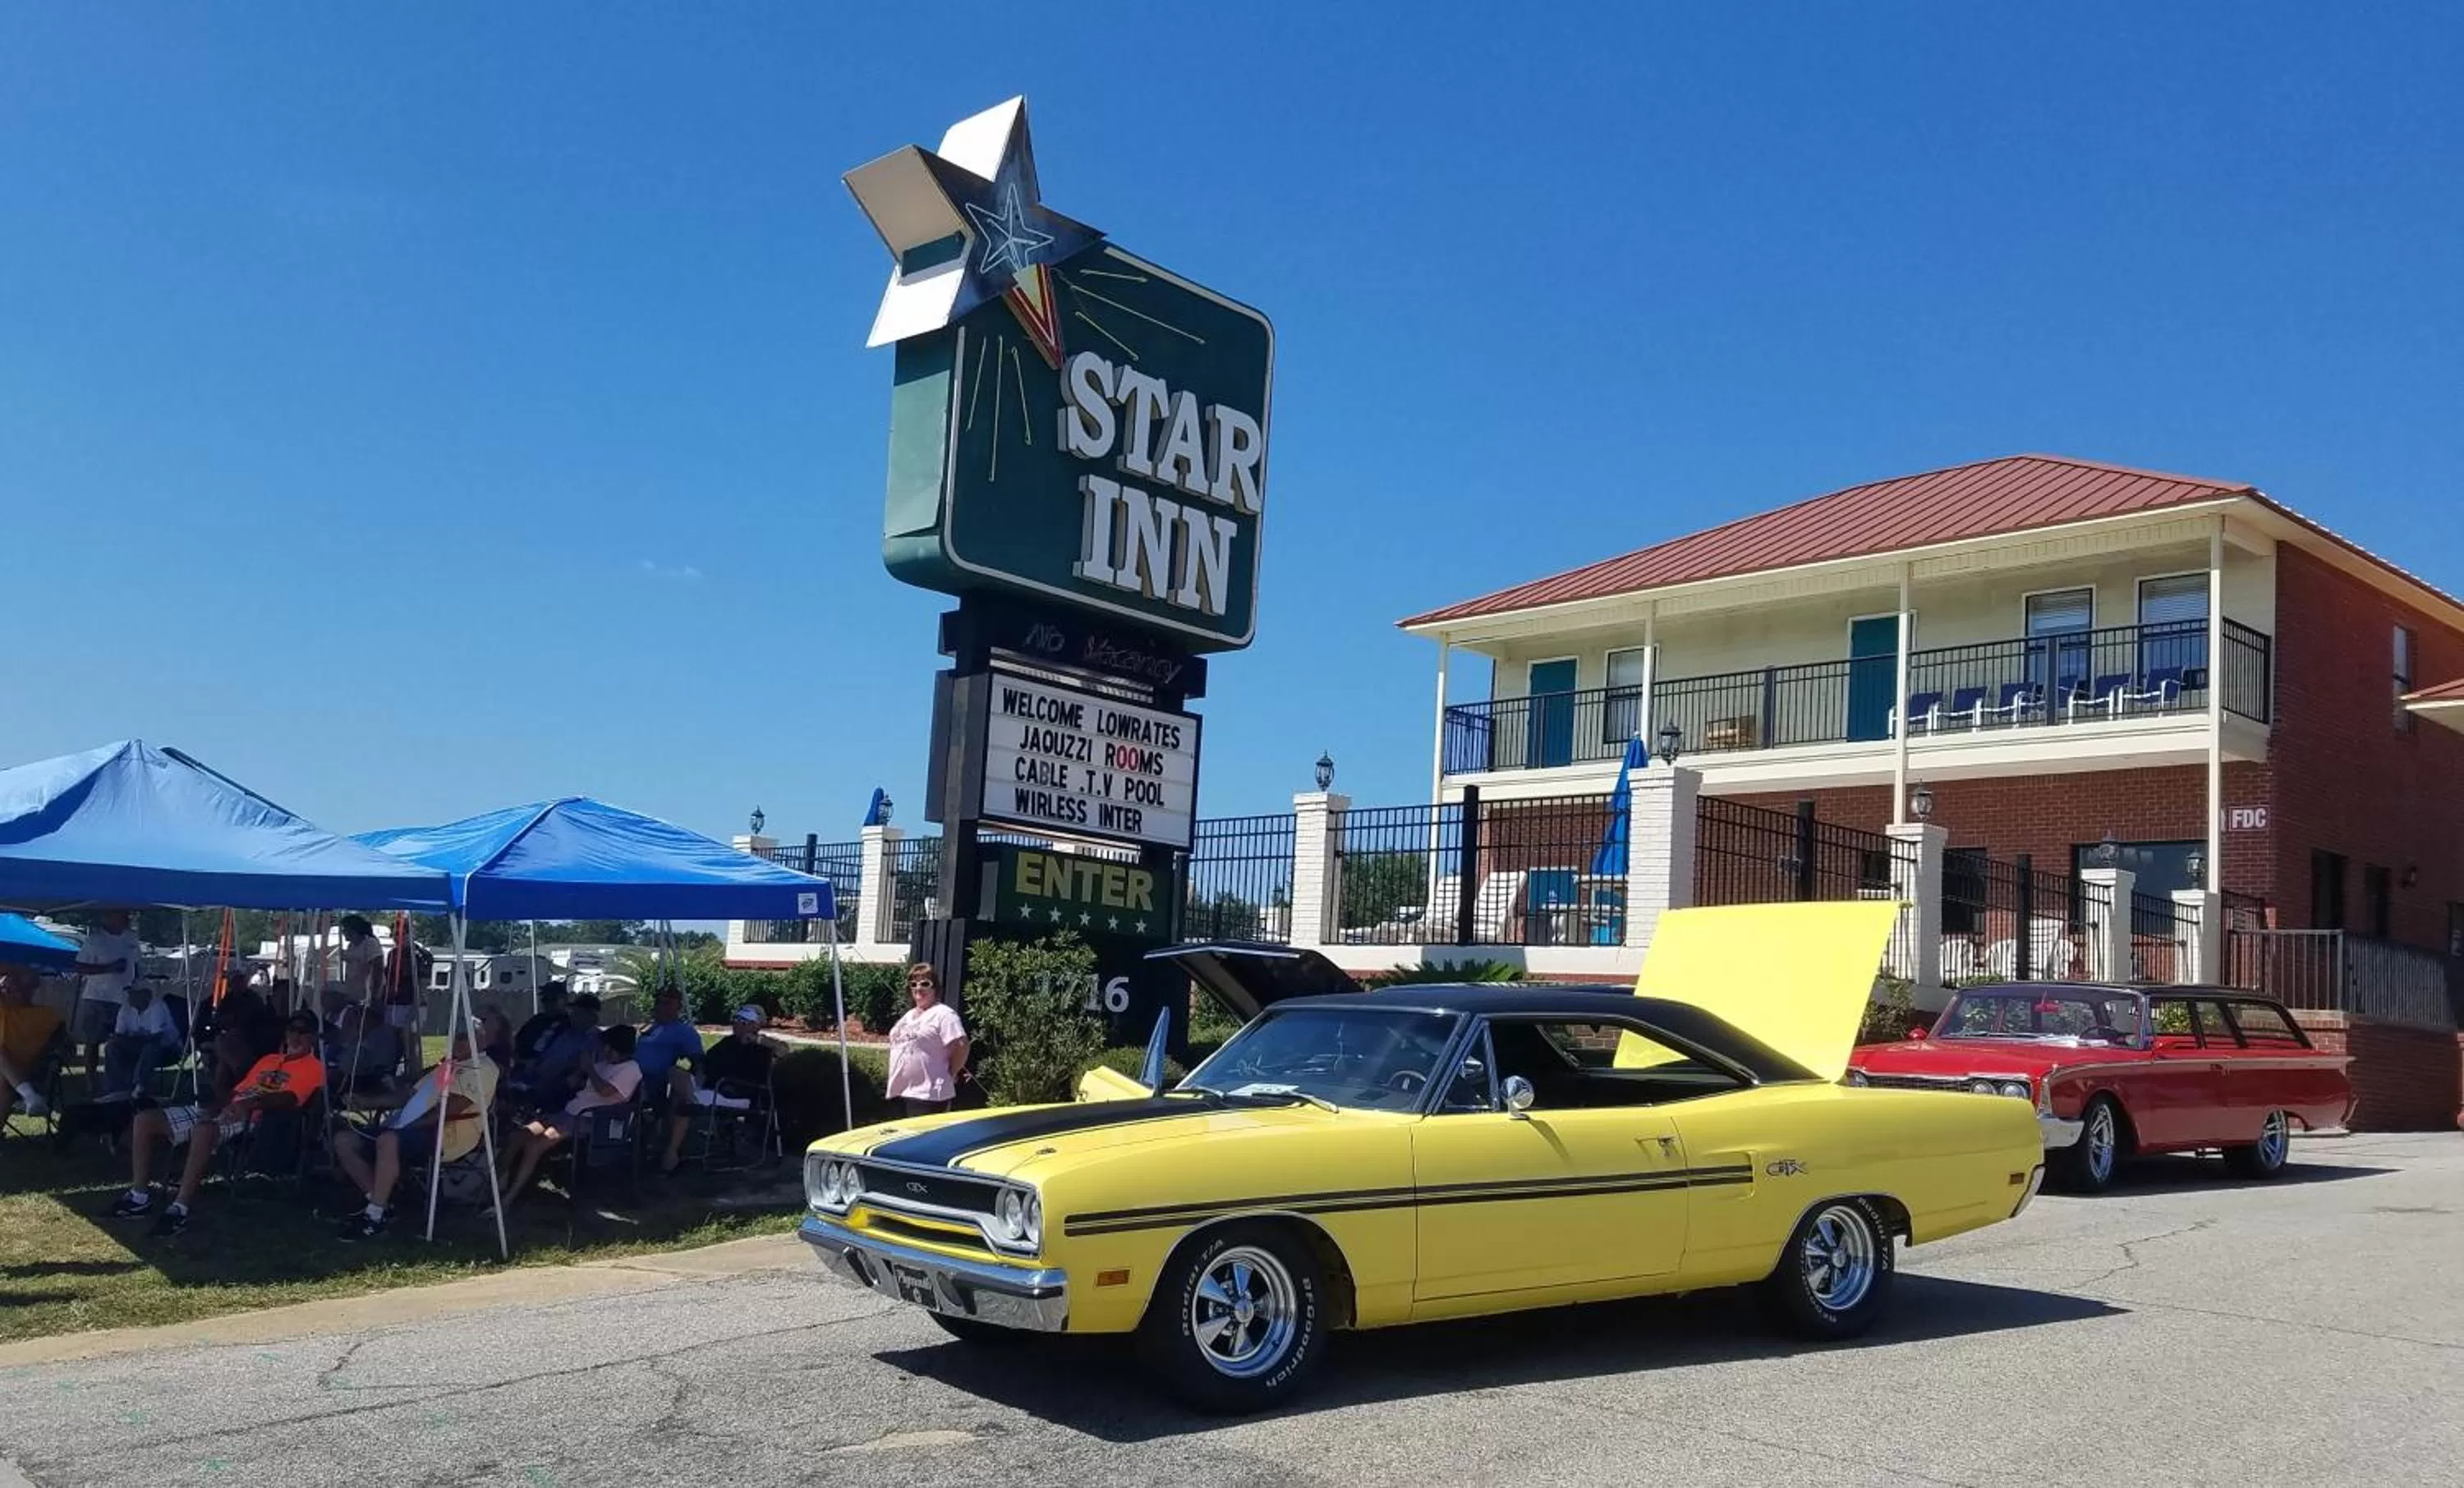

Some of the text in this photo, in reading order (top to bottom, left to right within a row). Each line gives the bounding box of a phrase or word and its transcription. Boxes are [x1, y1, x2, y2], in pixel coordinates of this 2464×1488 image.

[1058, 351, 1262, 513] STAR
[1073, 474, 1238, 616] INN
[1003, 687, 1180, 749] WELCOME LOWRATES
[1015, 757, 1068, 788] CABLE
[1124, 778, 1165, 806] POOL
[1106, 743, 1163, 775] ROOMS
[1015, 788, 1142, 833] WIRLESS INTER
[2232, 807, 2267, 829] FDC
[1015, 852, 1153, 912] ENTER
